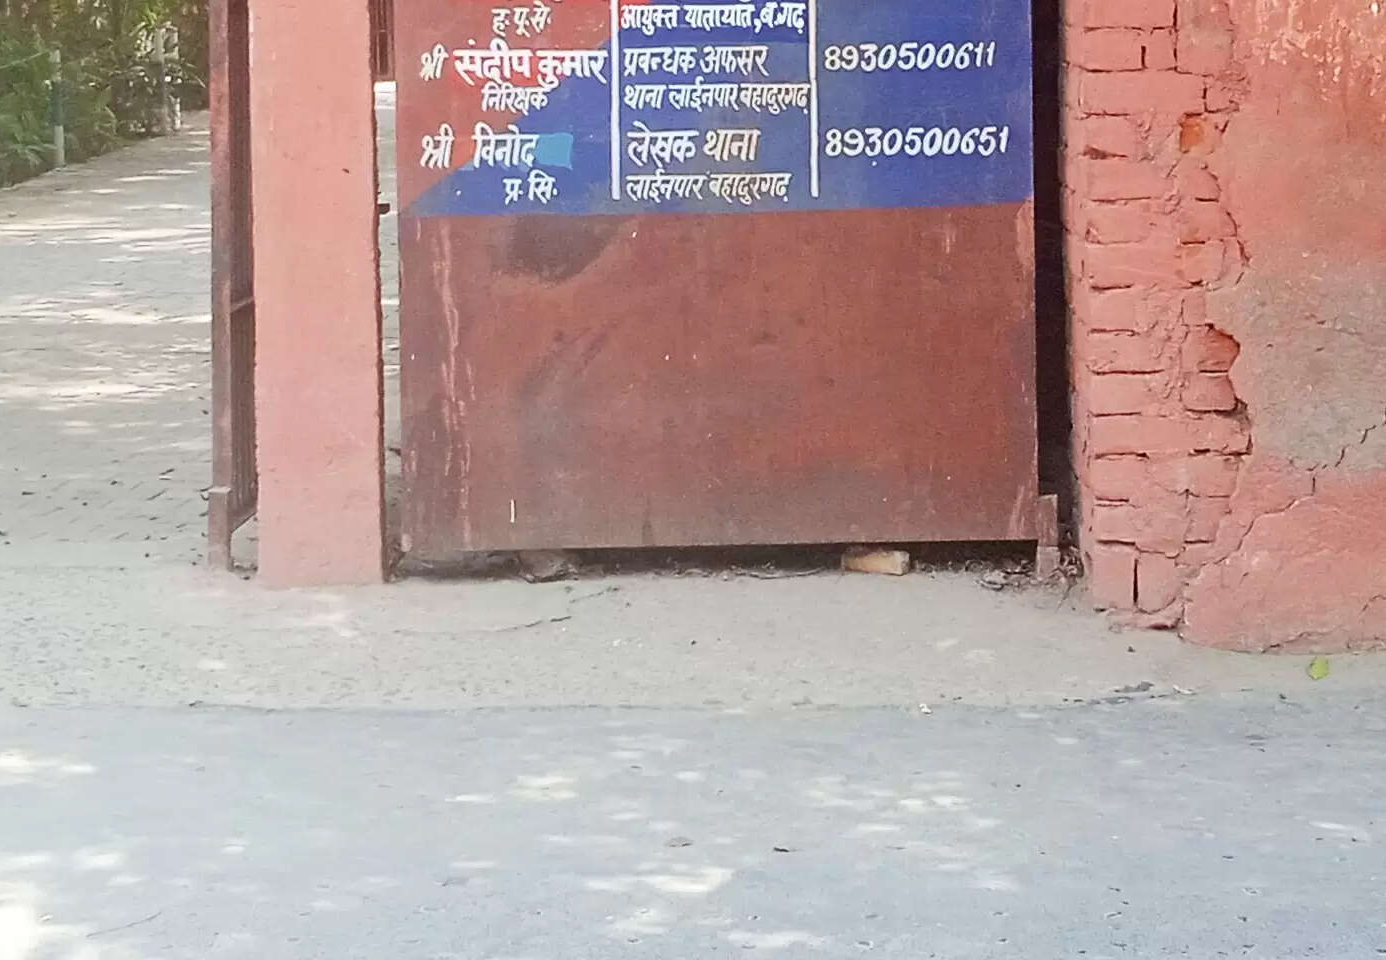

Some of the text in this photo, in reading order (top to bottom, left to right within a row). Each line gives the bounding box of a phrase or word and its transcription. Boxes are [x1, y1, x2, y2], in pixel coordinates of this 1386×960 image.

[621, 4, 680, 35] आयुक्त
[419, 38, 609, 88] श्री संदीप कुमार
[699, 46, 769, 76] अफसर
[824, 42, 995, 72] 8930500611
[624, 76, 810, 114] थाना लाईनपार बहादुरगढ़
[420, 121, 540, 169] श्री विनोद
[627, 121, 761, 167] लेखक थाना
[825, 126, 1009, 156] 8930500651
[626, 169, 792, 205] लाईनपार बहादुरगढ़
